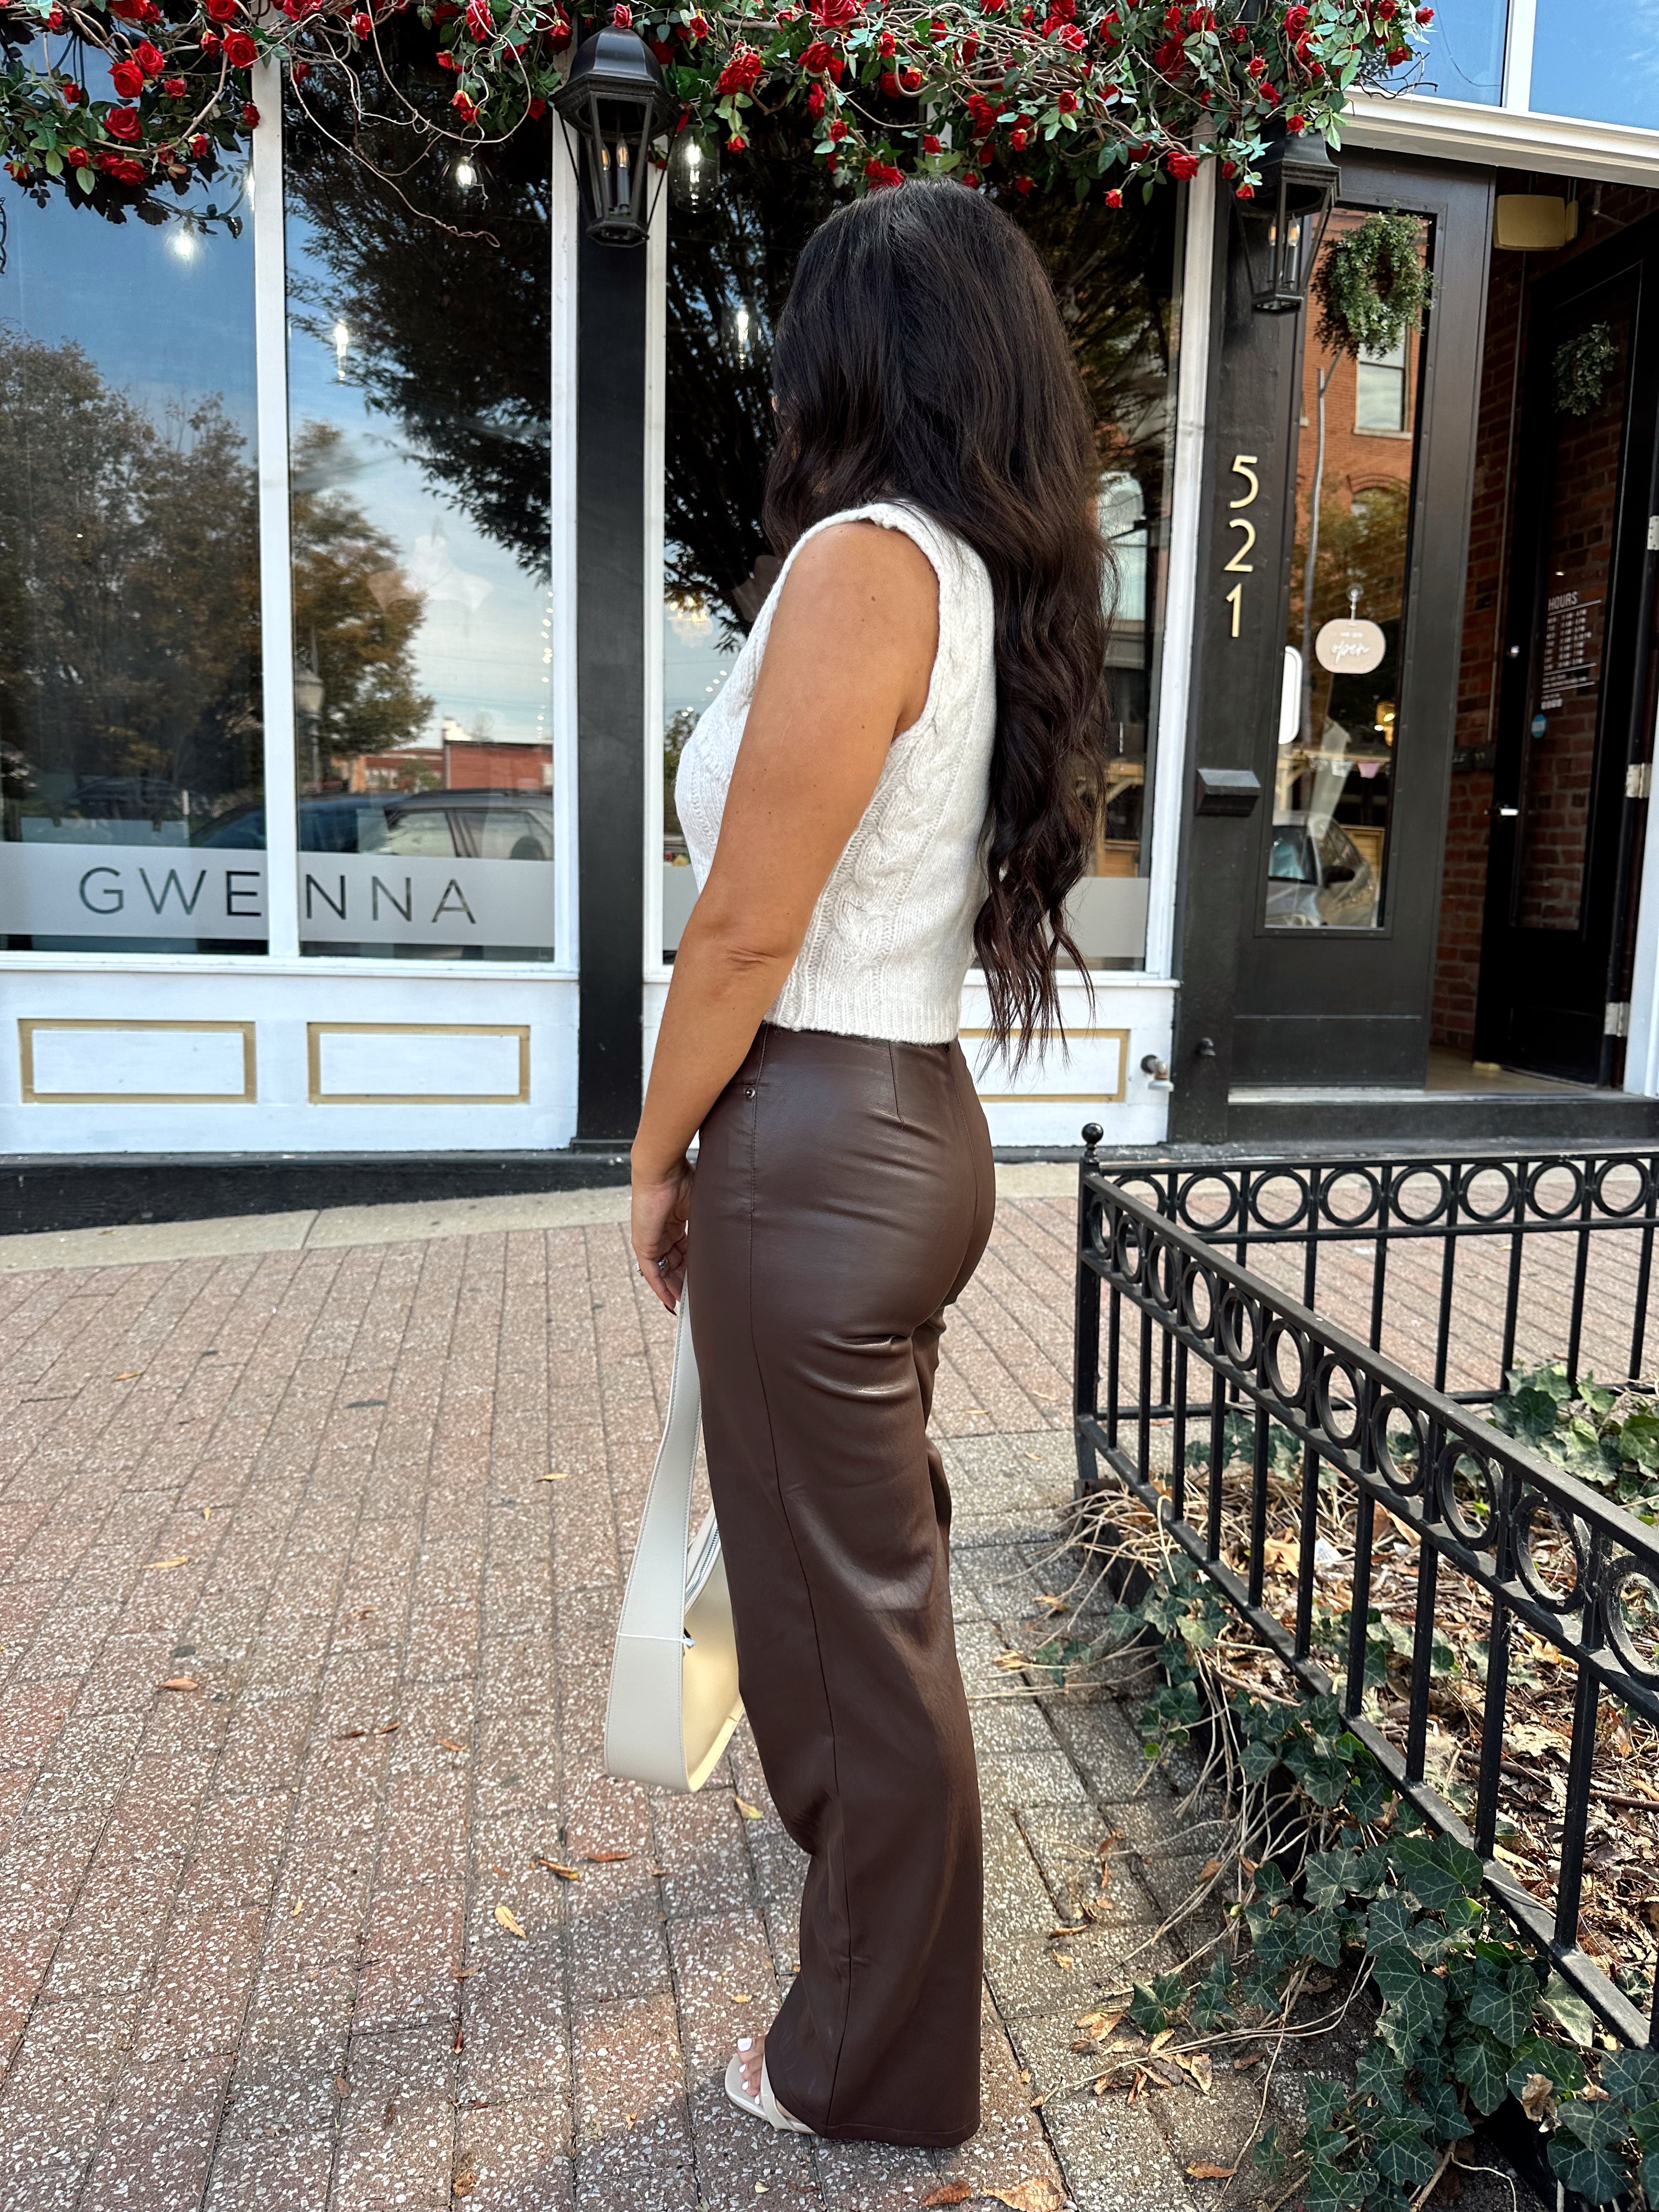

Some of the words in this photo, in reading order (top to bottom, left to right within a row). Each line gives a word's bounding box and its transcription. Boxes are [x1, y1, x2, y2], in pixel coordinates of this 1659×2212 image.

[1224, 454, 1260, 638] 521
[1548, 590, 1578, 611] HOURS
[78, 866, 477, 924] GWENNA
